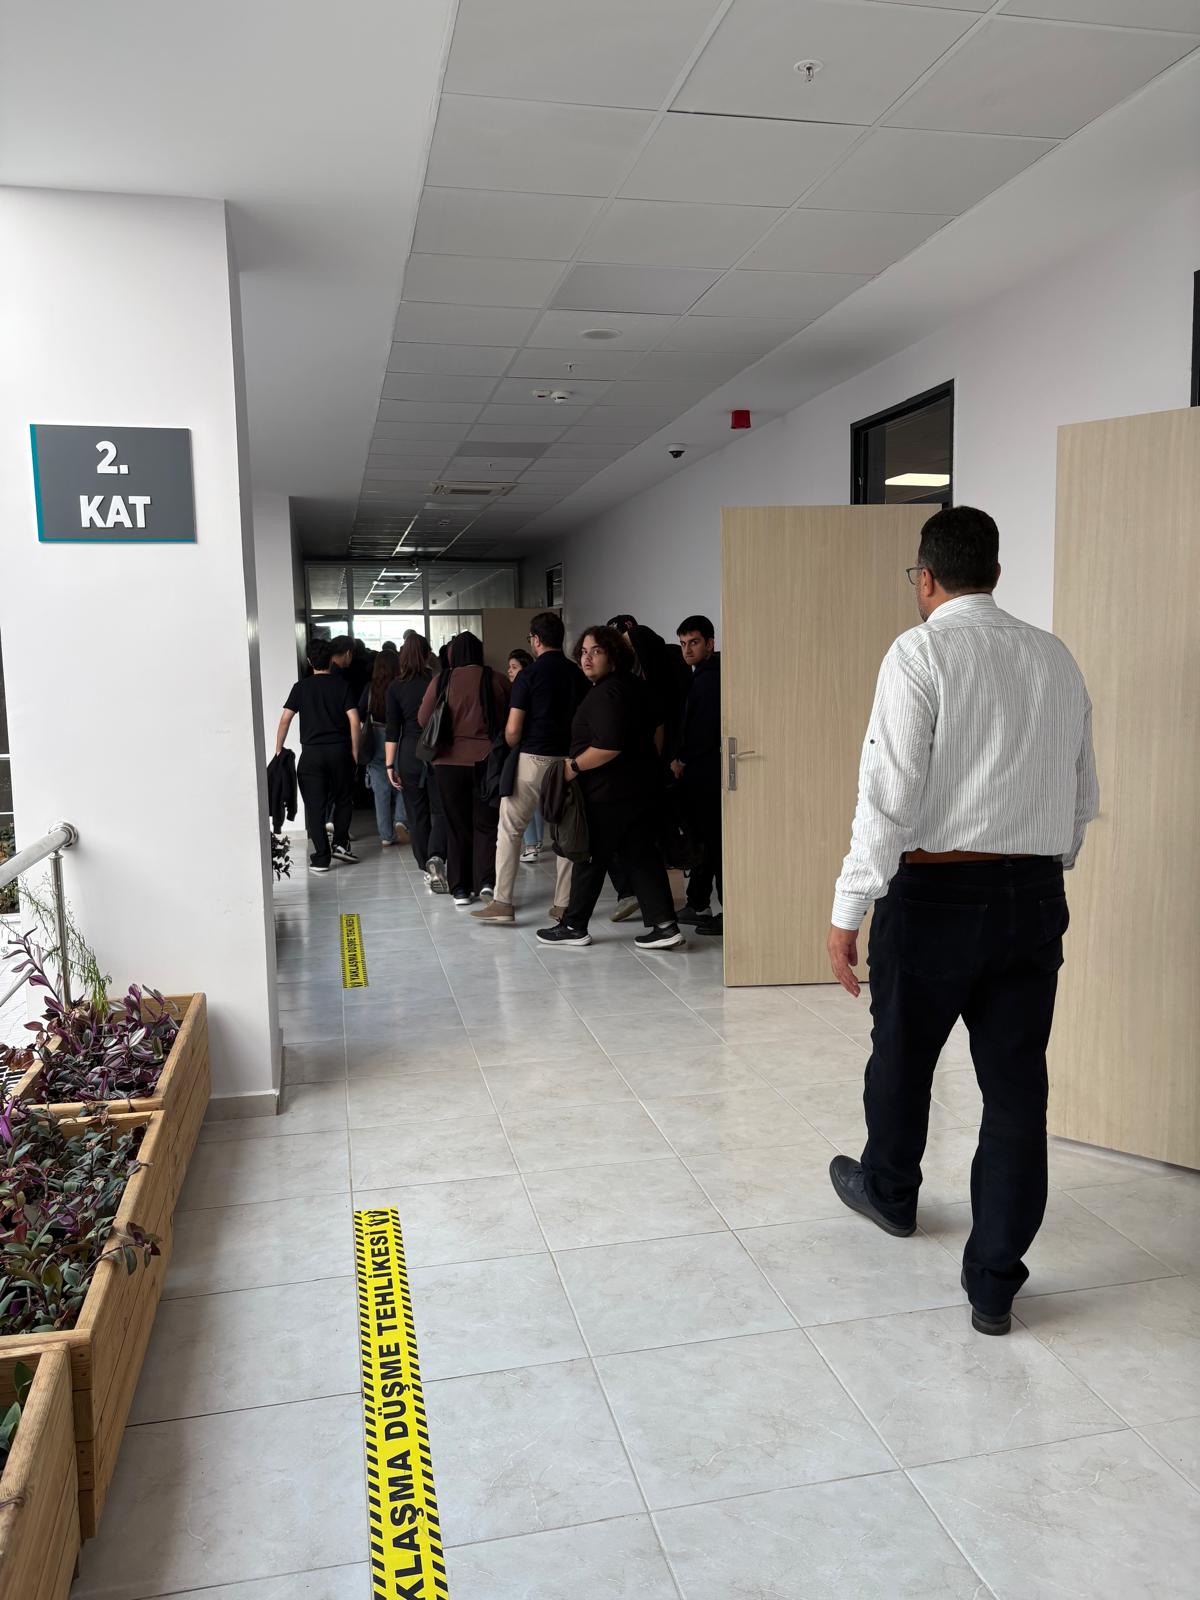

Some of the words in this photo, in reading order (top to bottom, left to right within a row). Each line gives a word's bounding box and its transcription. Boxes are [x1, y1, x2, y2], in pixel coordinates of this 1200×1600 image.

[95, 440, 129, 474] 2.
[79, 495, 151, 528] KAT
[369, 1230, 397, 1335] TEHLİKESİ
[378, 1343, 410, 1440] DÜŞME
